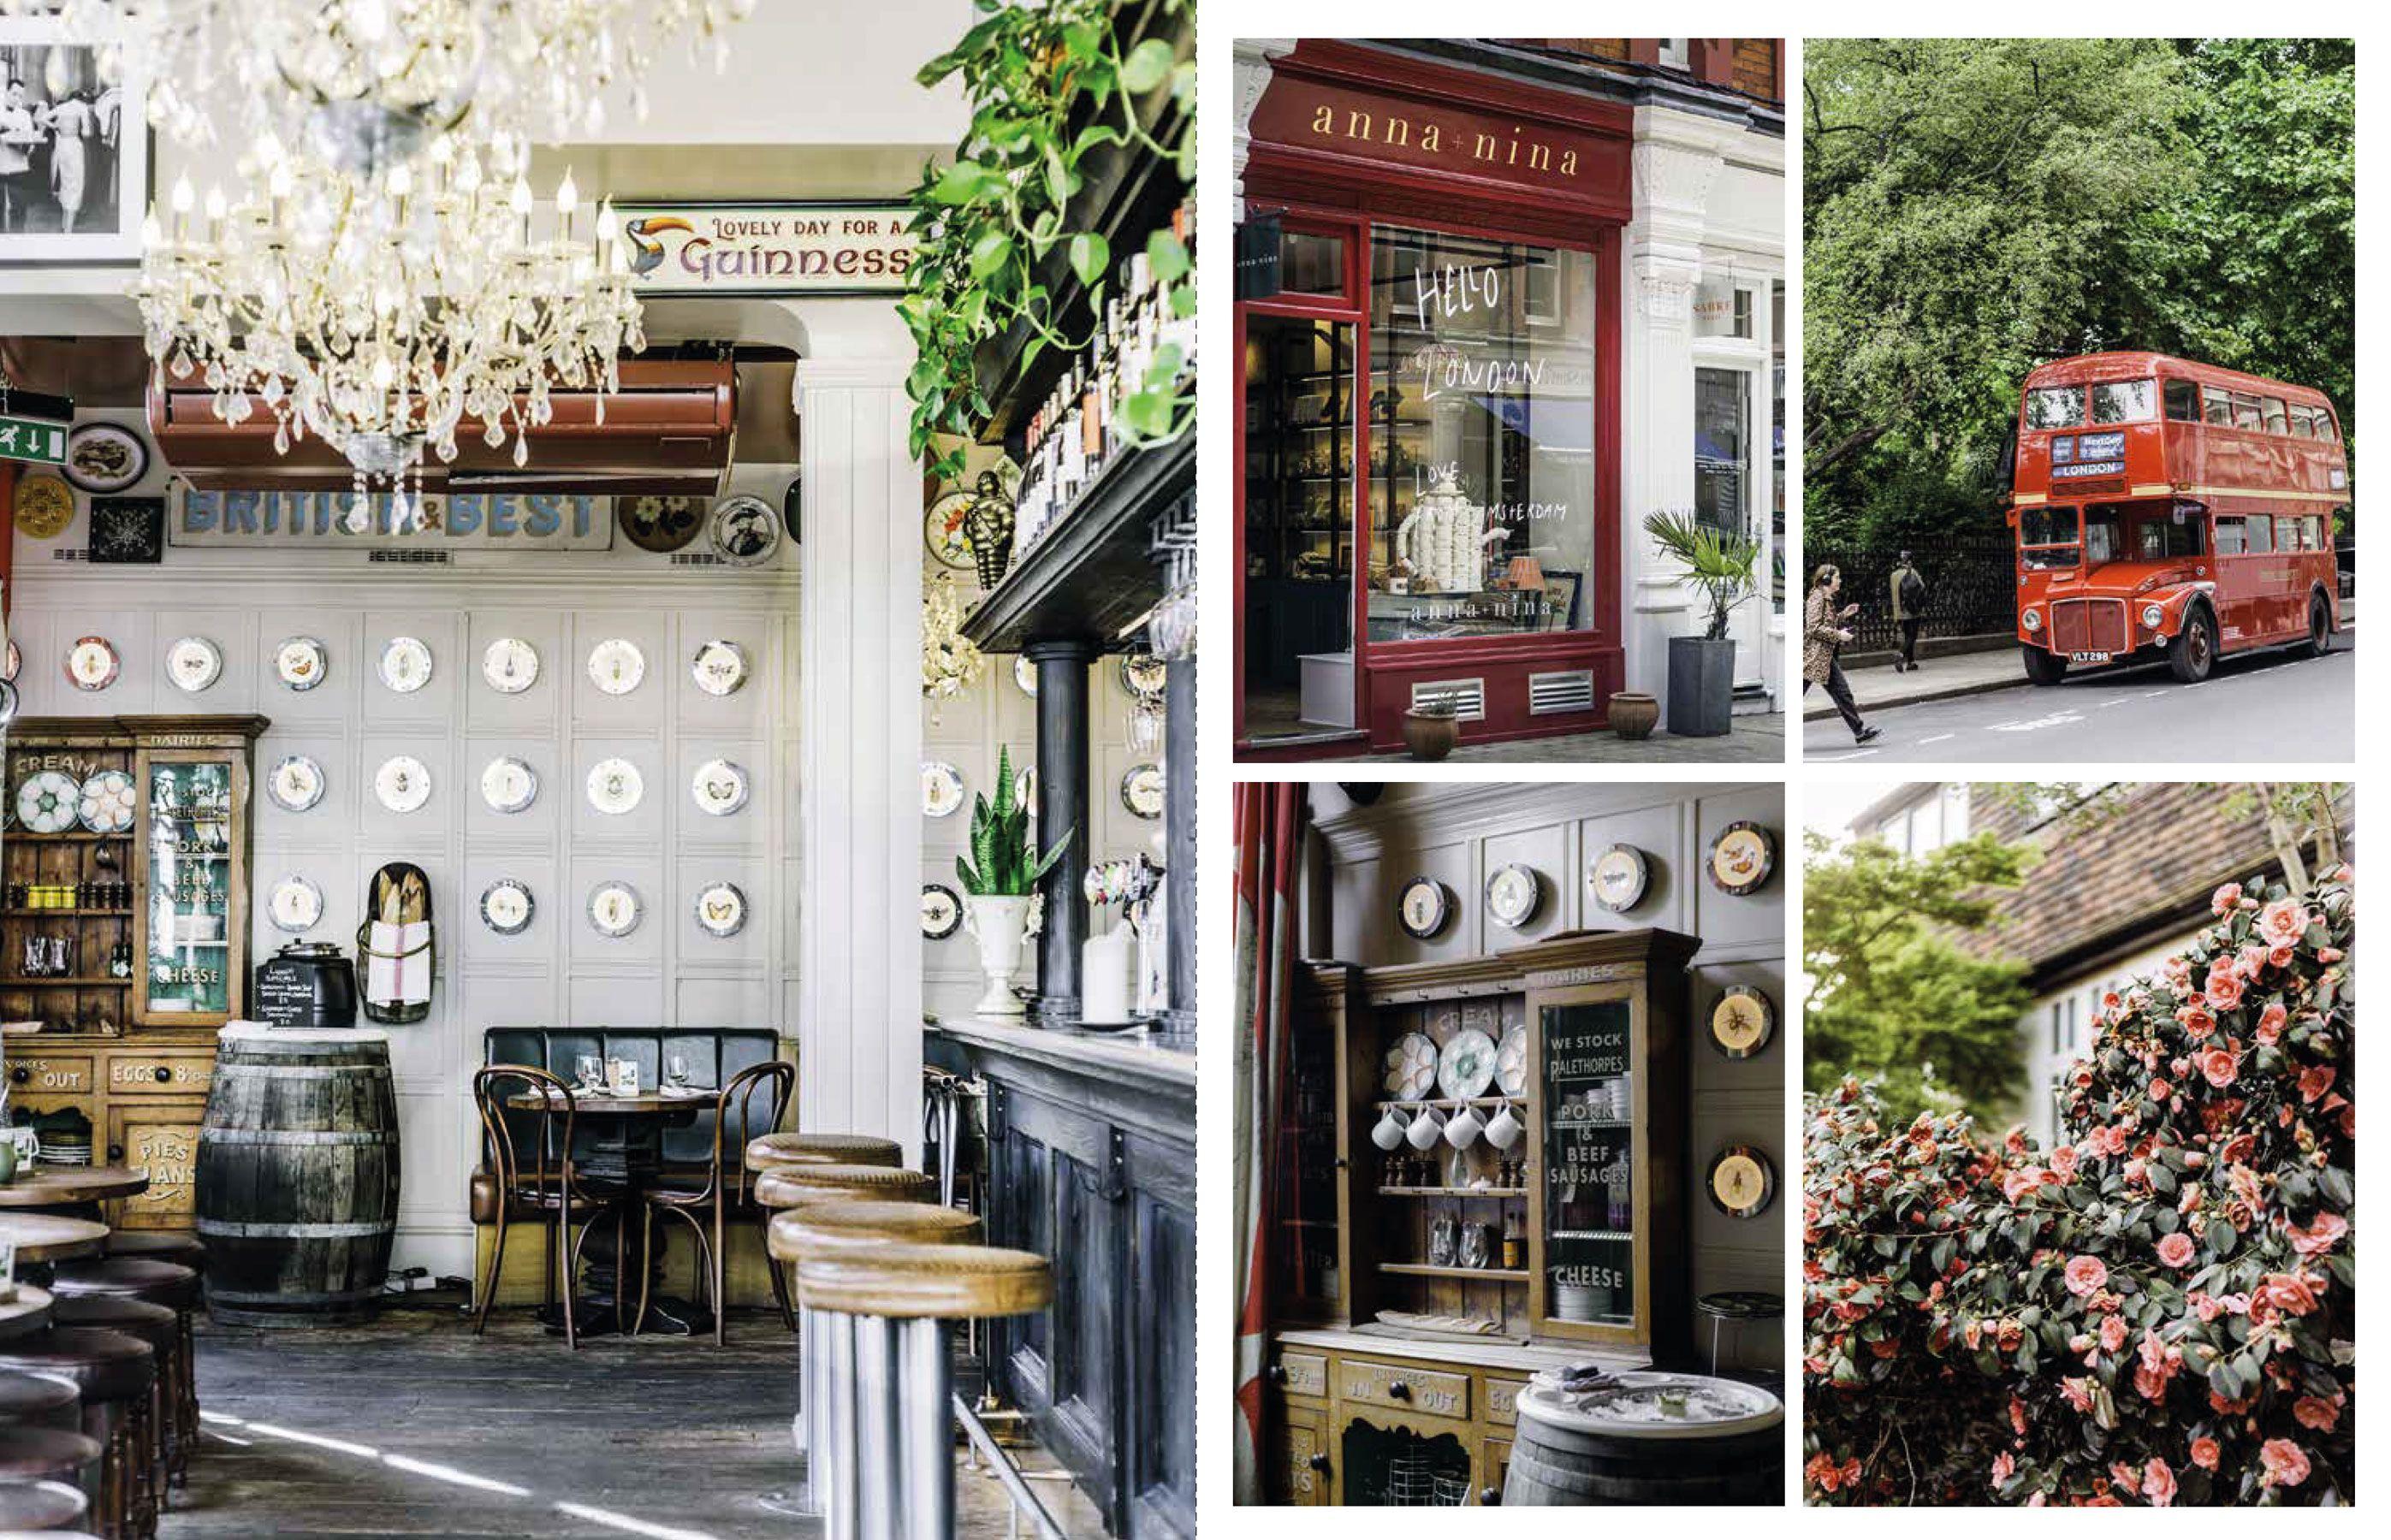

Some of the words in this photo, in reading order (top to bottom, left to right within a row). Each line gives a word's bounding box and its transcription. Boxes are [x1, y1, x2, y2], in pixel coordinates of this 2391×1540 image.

[712, 216, 781, 241] LOVELY
[794, 220, 830, 235] DAY
[843, 220, 879, 235] FOR
[890, 219, 901, 234] A
[680, 238, 912, 281] Guinness
[1415, 263, 1498, 331] HELLO
[1423, 352, 1546, 401] LONDON
[1416, 461, 1458, 498] LOVE
[2064, 463, 2115, 476] LONDON
[444, 495, 597, 537] BEST
[1486, 502, 1567, 522] MSTERDAM
[15, 755, 98, 778] CREAM
[176, 841, 213, 853] ORK
[1551, 1037, 1572, 1051] WE
[1576, 1034, 1623, 1049] STOCK
[44, 1071, 80, 1088] OUT
[1550, 1056, 1624, 1083] PALETHORPES
[1561, 1104, 1615, 1122] PORK
[139, 1140, 188, 1160] PIES
[1567, 1146, 1610, 1162] BEEF
[1550, 1167, 1630, 1184] SAUSAGES
[1555, 1265, 1624, 1288] CHEESE
[1423, 1391, 1457, 1411] OUT
